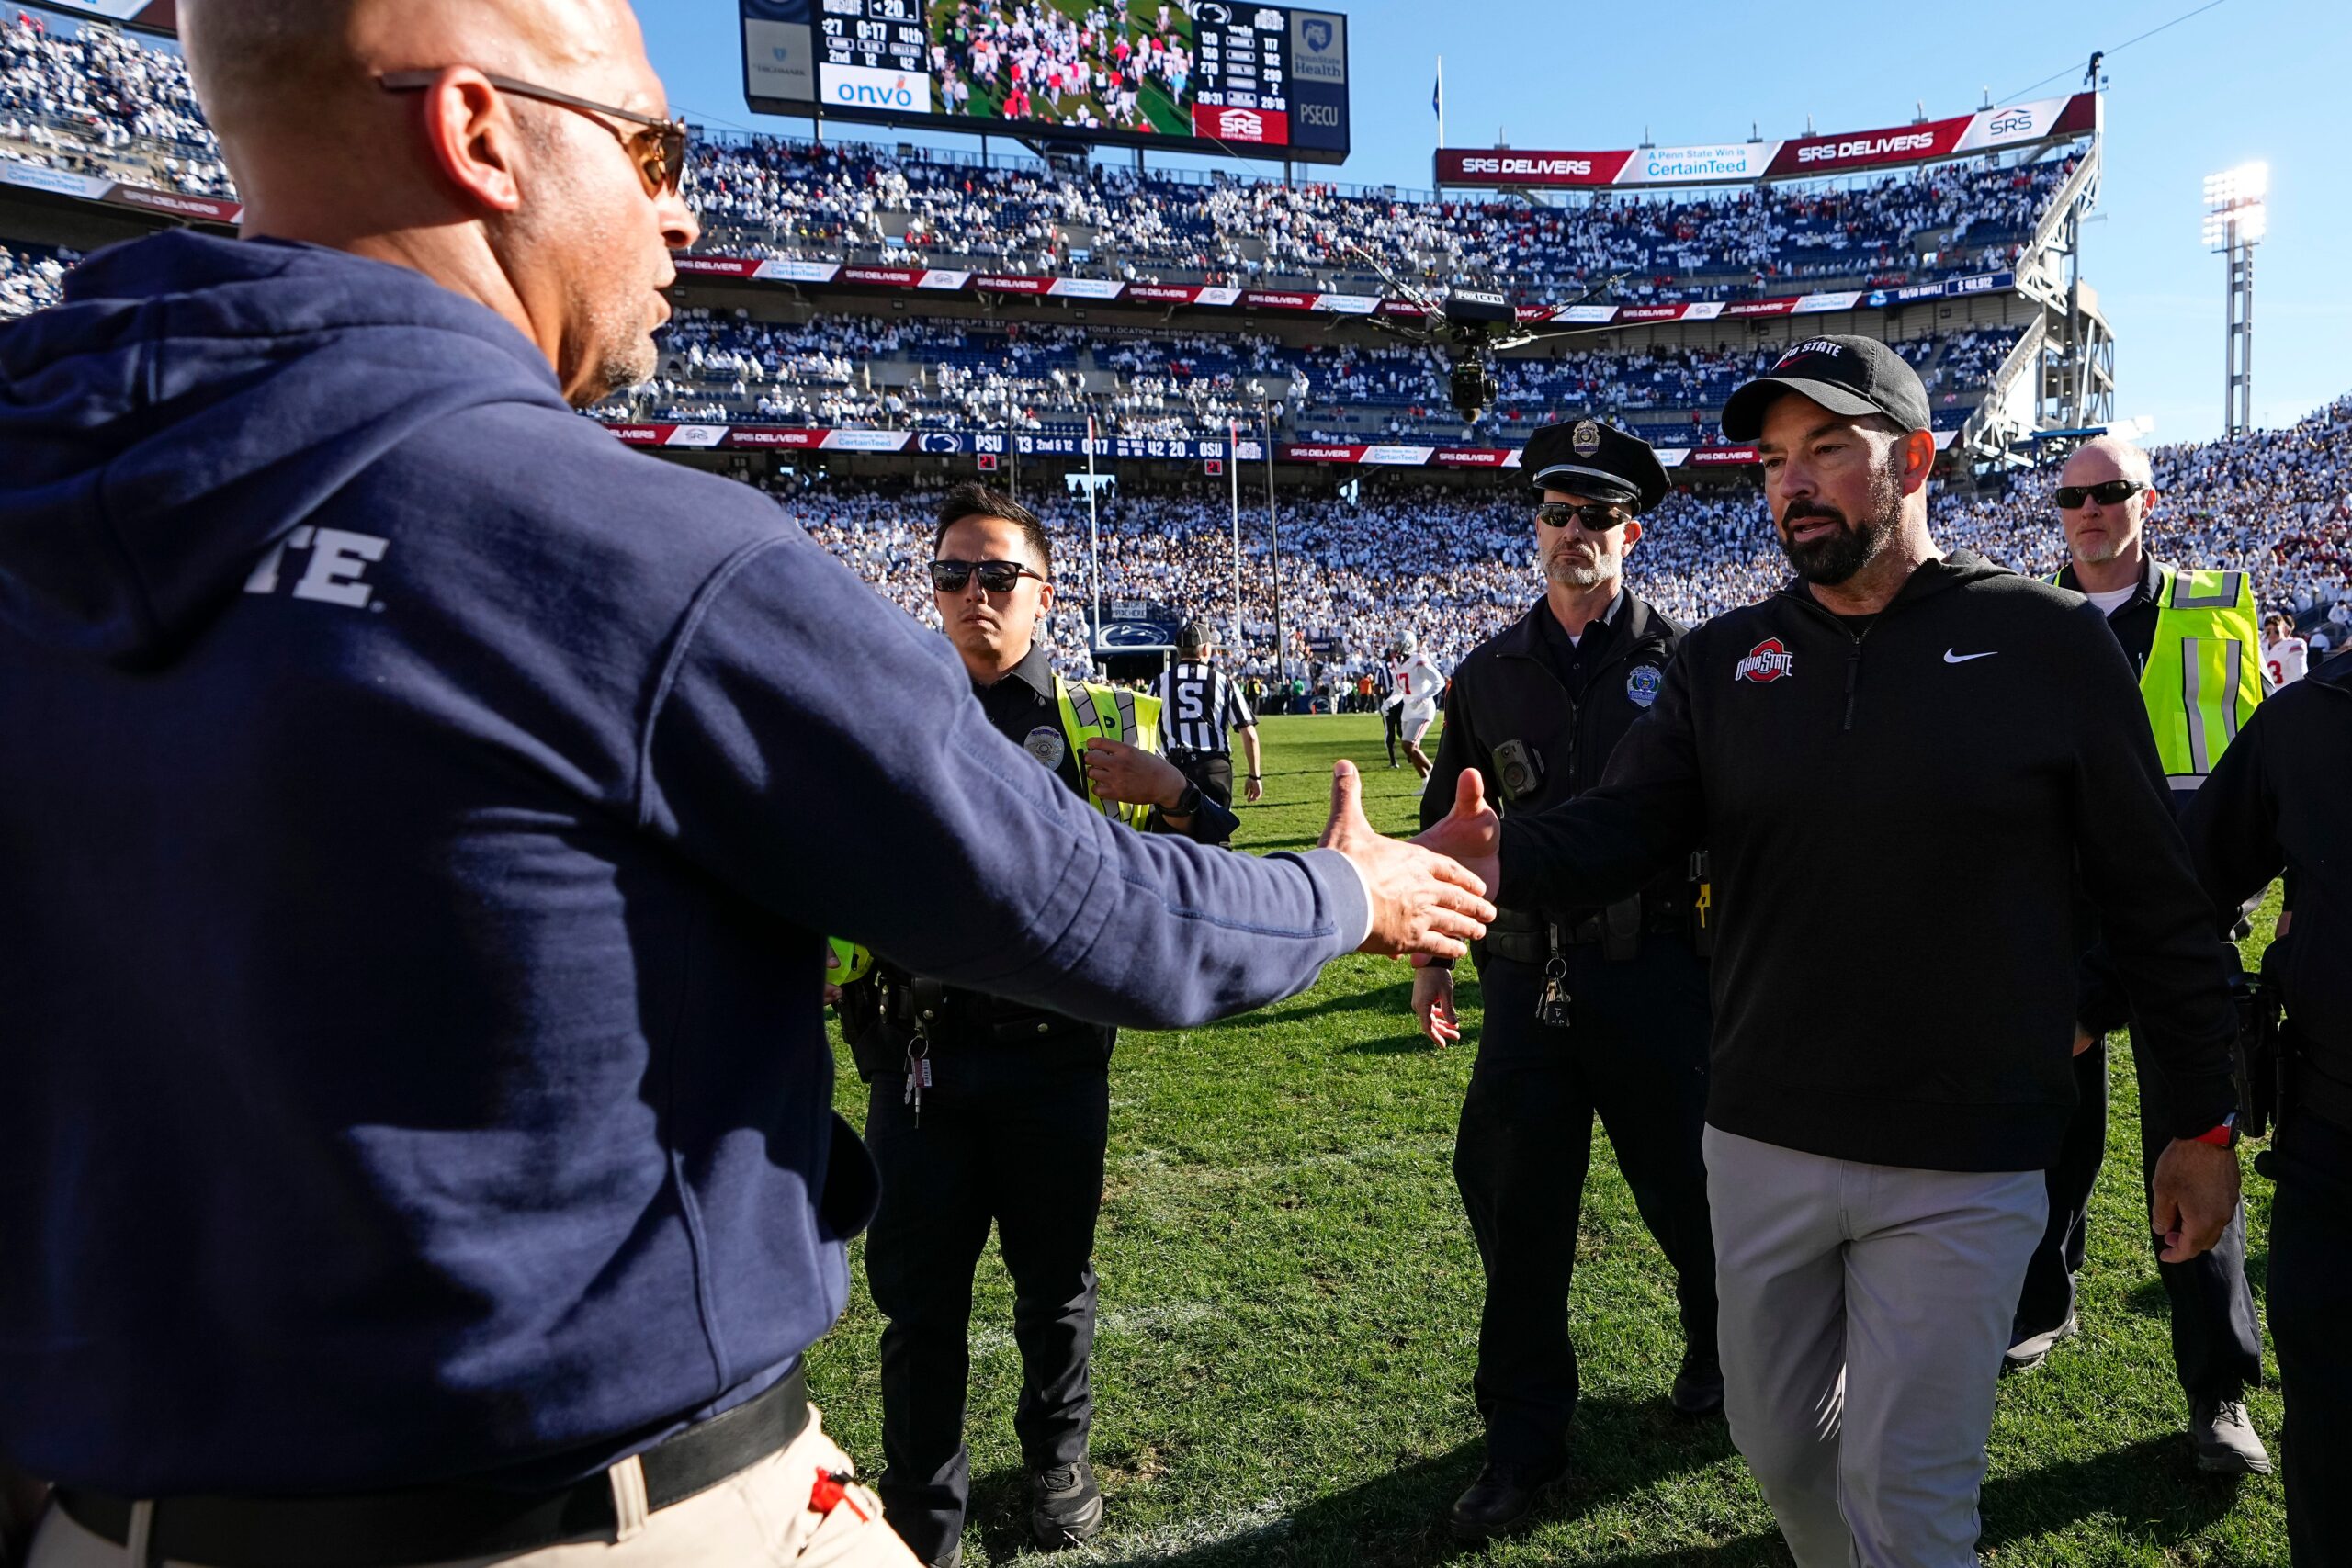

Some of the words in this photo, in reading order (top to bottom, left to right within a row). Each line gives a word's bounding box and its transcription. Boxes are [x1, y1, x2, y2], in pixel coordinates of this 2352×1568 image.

[856, 20, 887, 41] 0:17
[899, 26, 924, 45] 4th
[829, 49, 851, 64] 2nd
[865, 52, 877, 67] 12
[900, 56, 915, 71] 42
[1295, 62, 1341, 77] Health
[838, 83, 911, 107] onvo
[1271, 82, 1279, 96] 2
[1300, 103, 1339, 127] PSECU
[1219, 117, 1263, 135] SRS
[1990, 115, 2032, 136] SRS
[1797, 143, 1838, 163] SRS
[1838, 131, 1934, 158] DELIVERS
[1648, 152, 1657, 160] A
[1658, 151, 1684, 160] Penn
[1687, 149, 1713, 159] State
[1715, 149, 1734, 157] Win
[1462, 158, 1499, 173] SRS
[1501, 159, 1591, 175] DELIVERS
[1648, 159, 1747, 176] CertainTeed
[695, 261, 742, 272] DELIVERS
[845, 269, 865, 279] SRS
[865, 271, 910, 282] DELIVERS
[995, 279, 1039, 289] DELIVERS
[1147, 288, 1188, 298] DELIVERS
[1638, 309, 1675, 317] DELIVERS
[1801, 341, 1842, 357] STATE
[608, 429, 656, 439] ELIVERS
[733, 434, 754, 442] SRS
[755, 434, 808, 444] DELIVERS
[838, 438, 891, 447] CertainTeed
[975, 434, 1002, 452] PSU
[1017, 436, 1033, 453] 13
[1036, 438, 1053, 451] 2nd
[1063, 439, 1074, 452] 12
[1148, 441, 1164, 457] 42
[1169, 442, 1186, 457] 20
[1199, 442, 1223, 457] OSU
[1290, 448, 1307, 457] SRS
[1308, 449, 1350, 457] DELIVERS
[1439, 453, 1455, 461] SRS
[1455, 453, 1495, 462] DELIVERS
[1695, 453, 1712, 461] SRS
[1712, 451, 1753, 460] DELIVERS
[979, 456, 995, 468] 27
[1177, 682, 1204, 719] S
